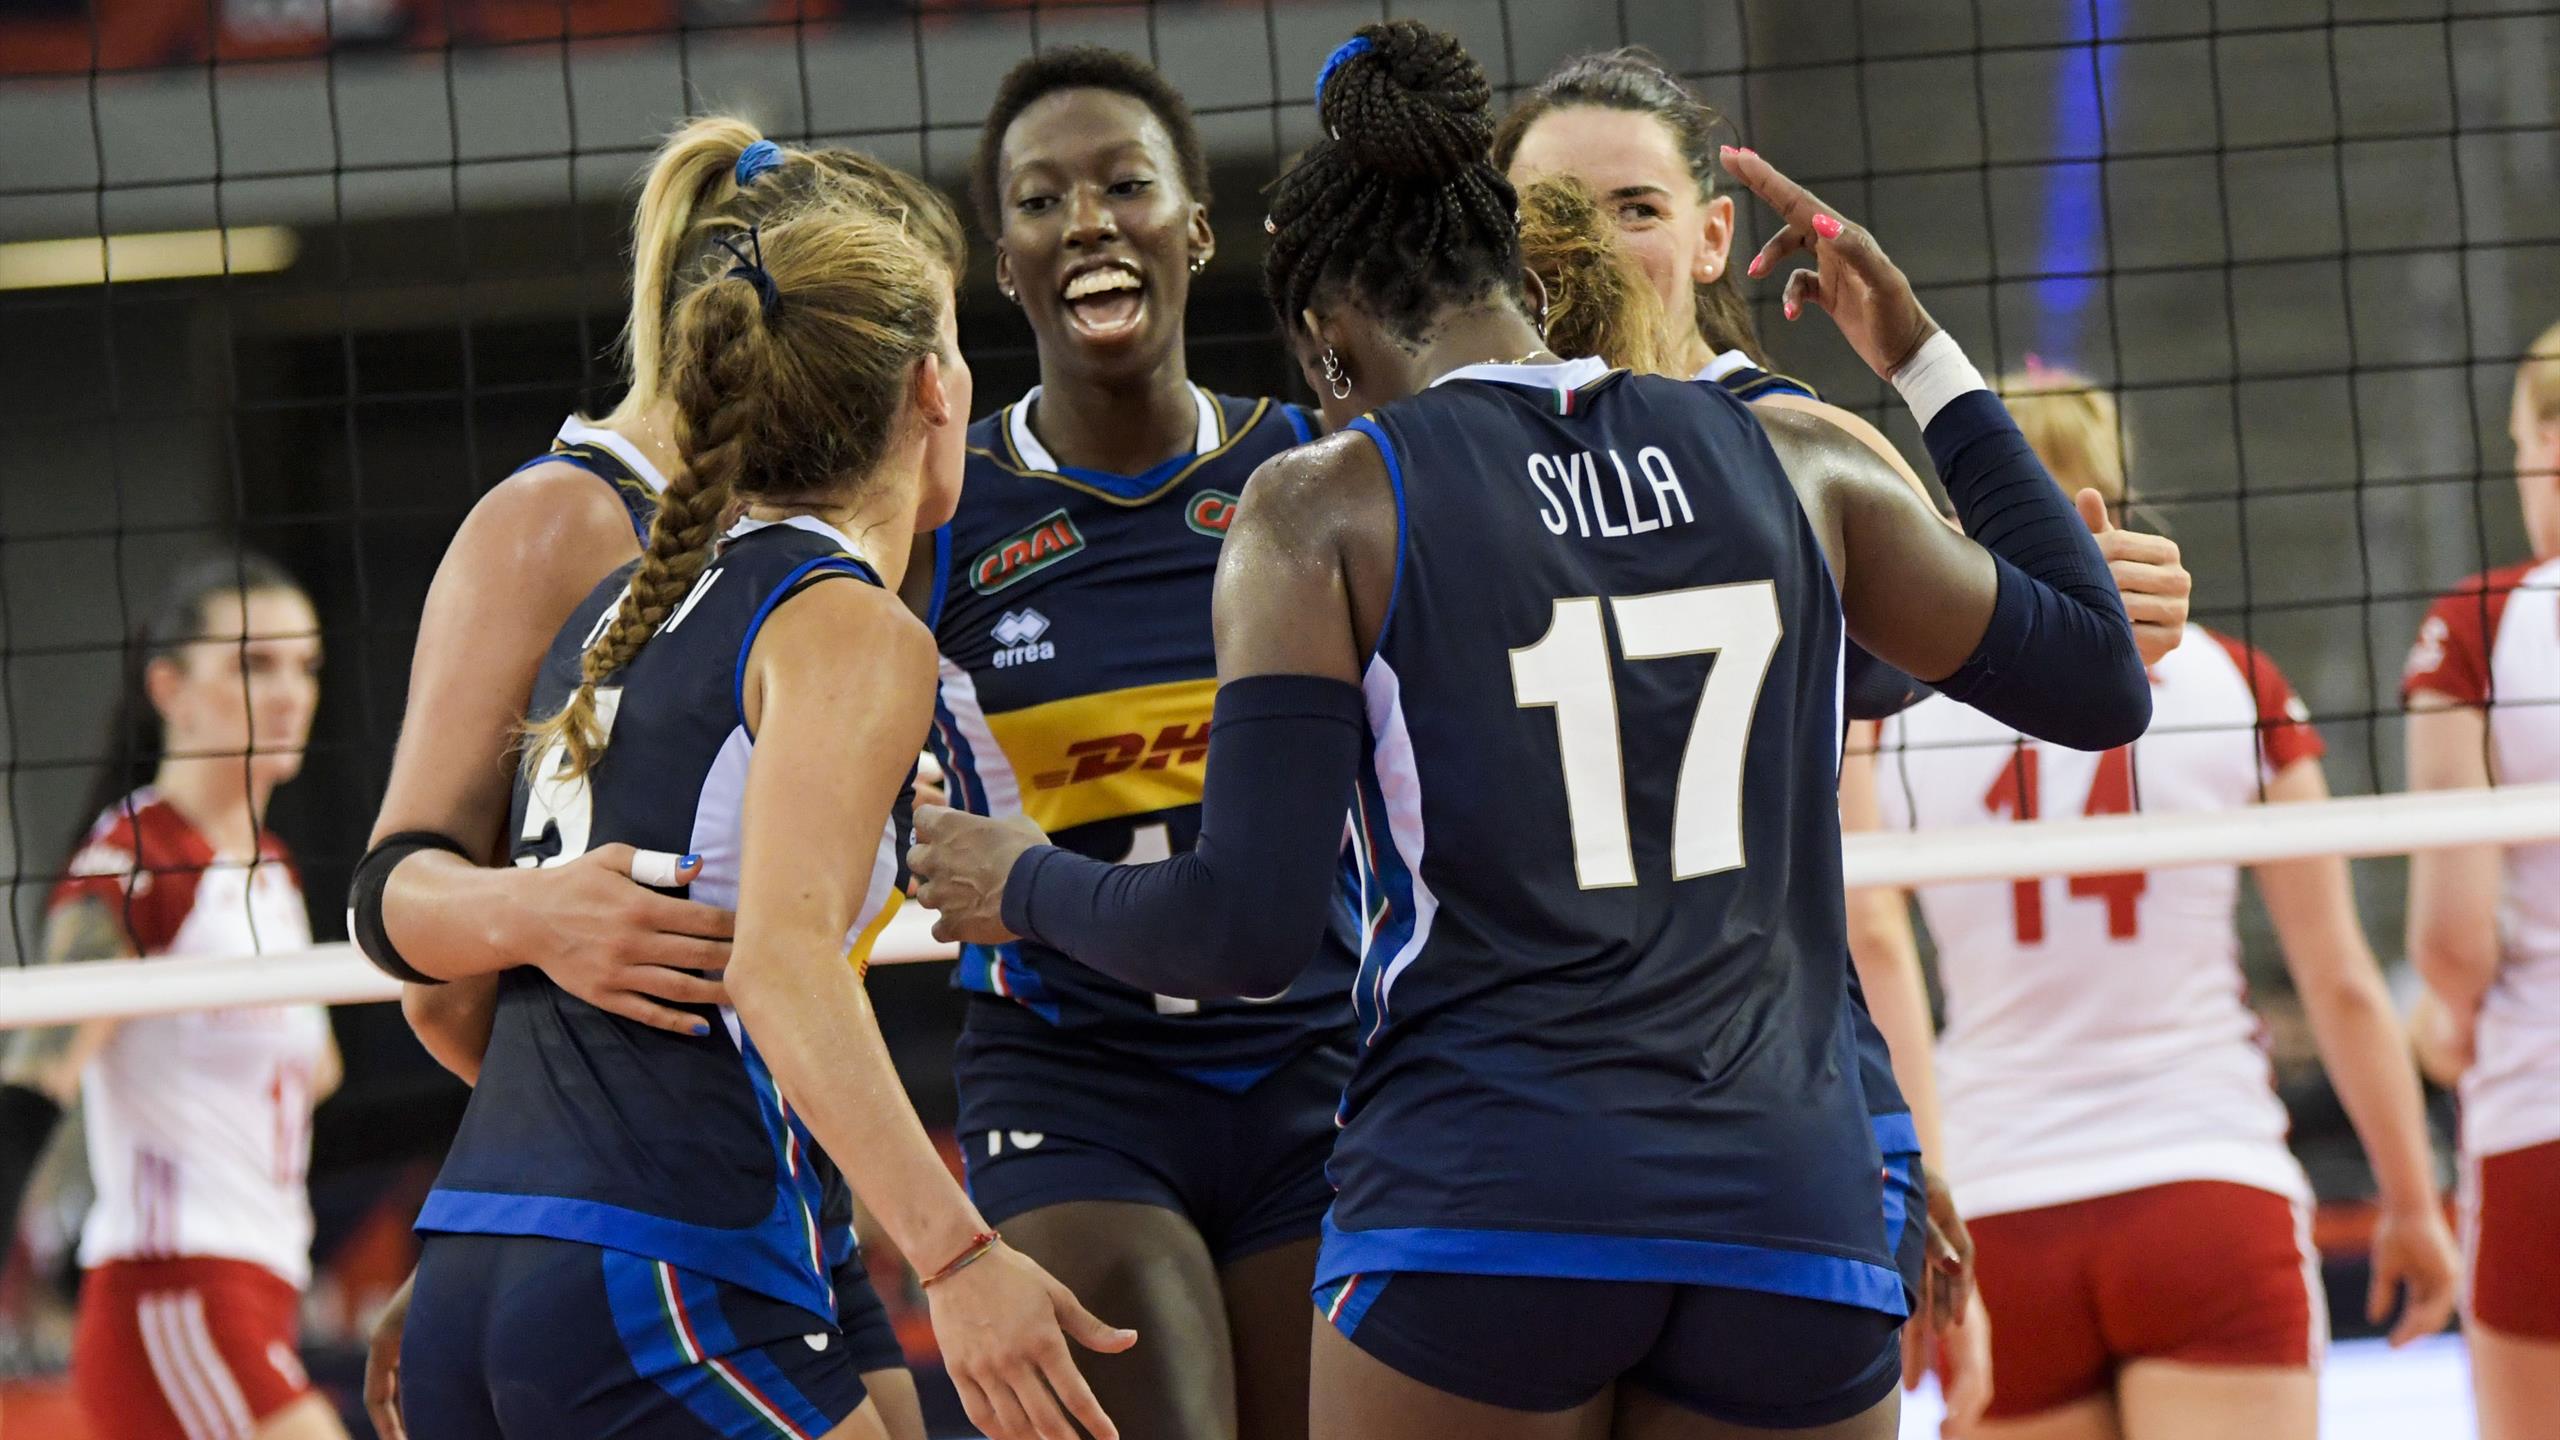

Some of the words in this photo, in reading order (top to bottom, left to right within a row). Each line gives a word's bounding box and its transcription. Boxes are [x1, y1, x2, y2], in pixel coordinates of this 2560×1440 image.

[1527, 446, 1694, 537] SYLLA
[979, 519, 1075, 584] CRAI
[1067, 722, 1211, 784] DH
[1508, 579, 1784, 890] 17
[1984, 746, 2147, 943] 14
